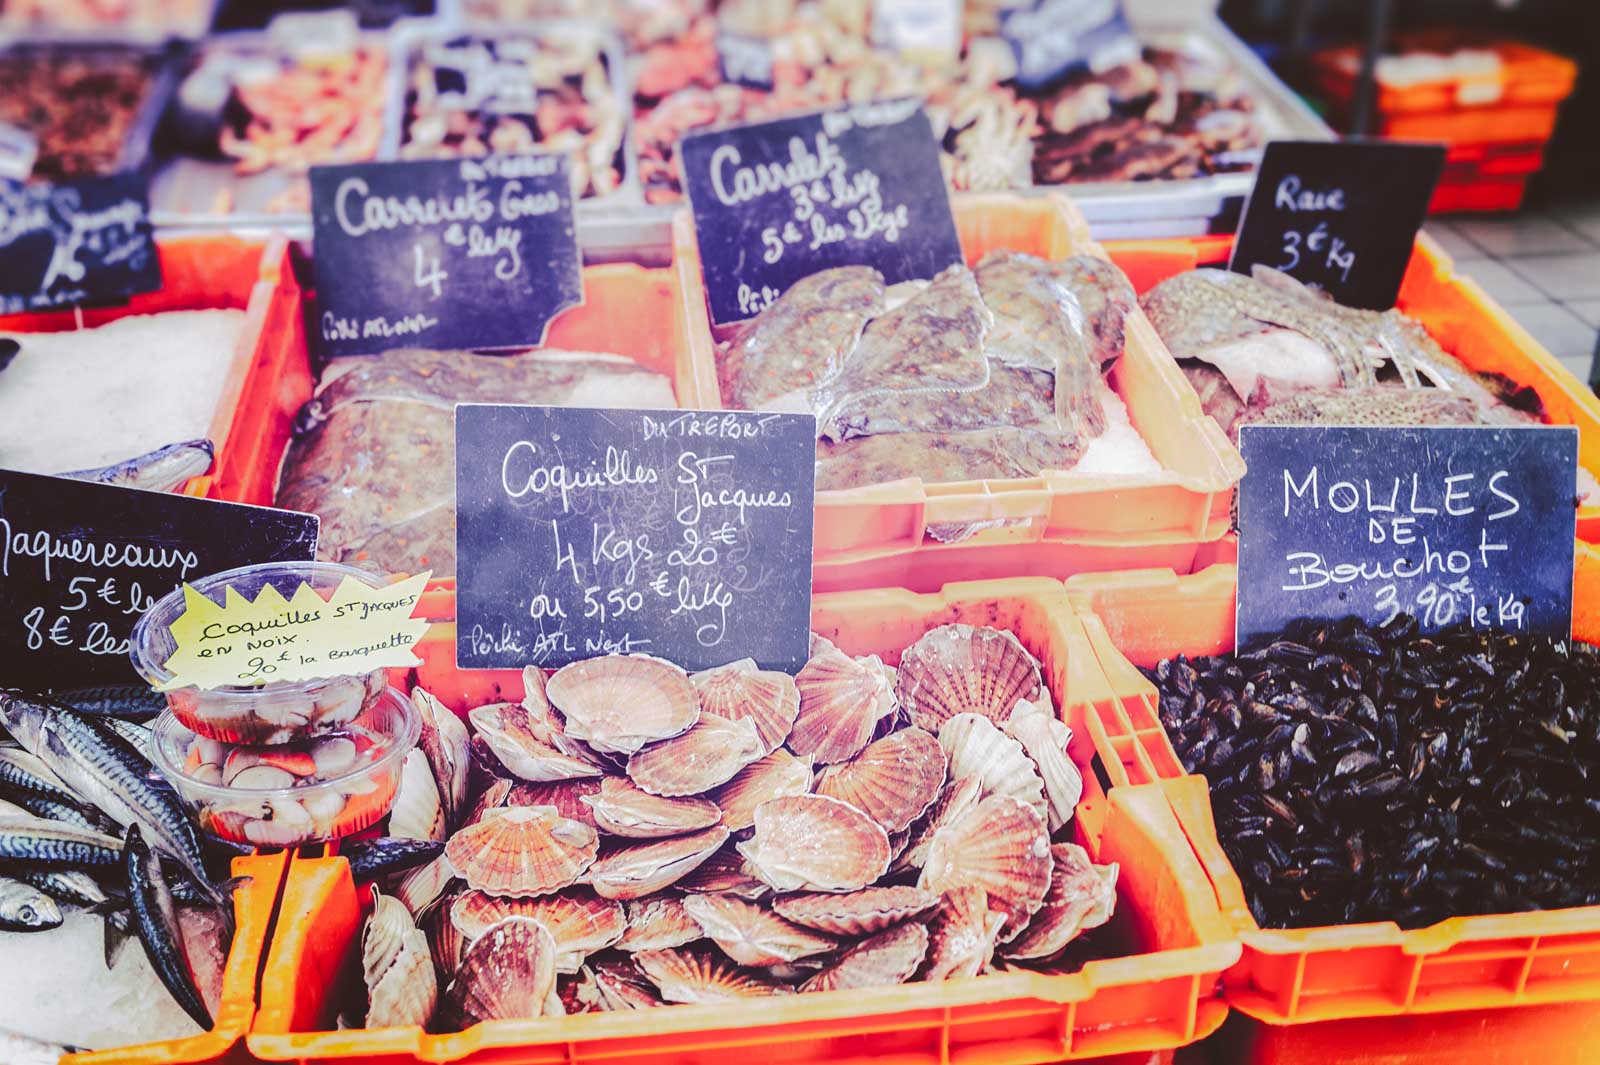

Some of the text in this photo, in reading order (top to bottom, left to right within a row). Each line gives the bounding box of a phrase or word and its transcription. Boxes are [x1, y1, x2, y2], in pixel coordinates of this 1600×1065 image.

[502, 441, 658, 514] Coquilles
[1282, 465, 1521, 520] MOULES
[676, 482, 791, 526] Jacques
[552, 519, 581, 584] 4
[1368, 517, 1418, 544] DE
[1282, 528, 1509, 592] Bouchot
[198, 609, 321, 643] Coquilles
[530, 592, 567, 620] ou
